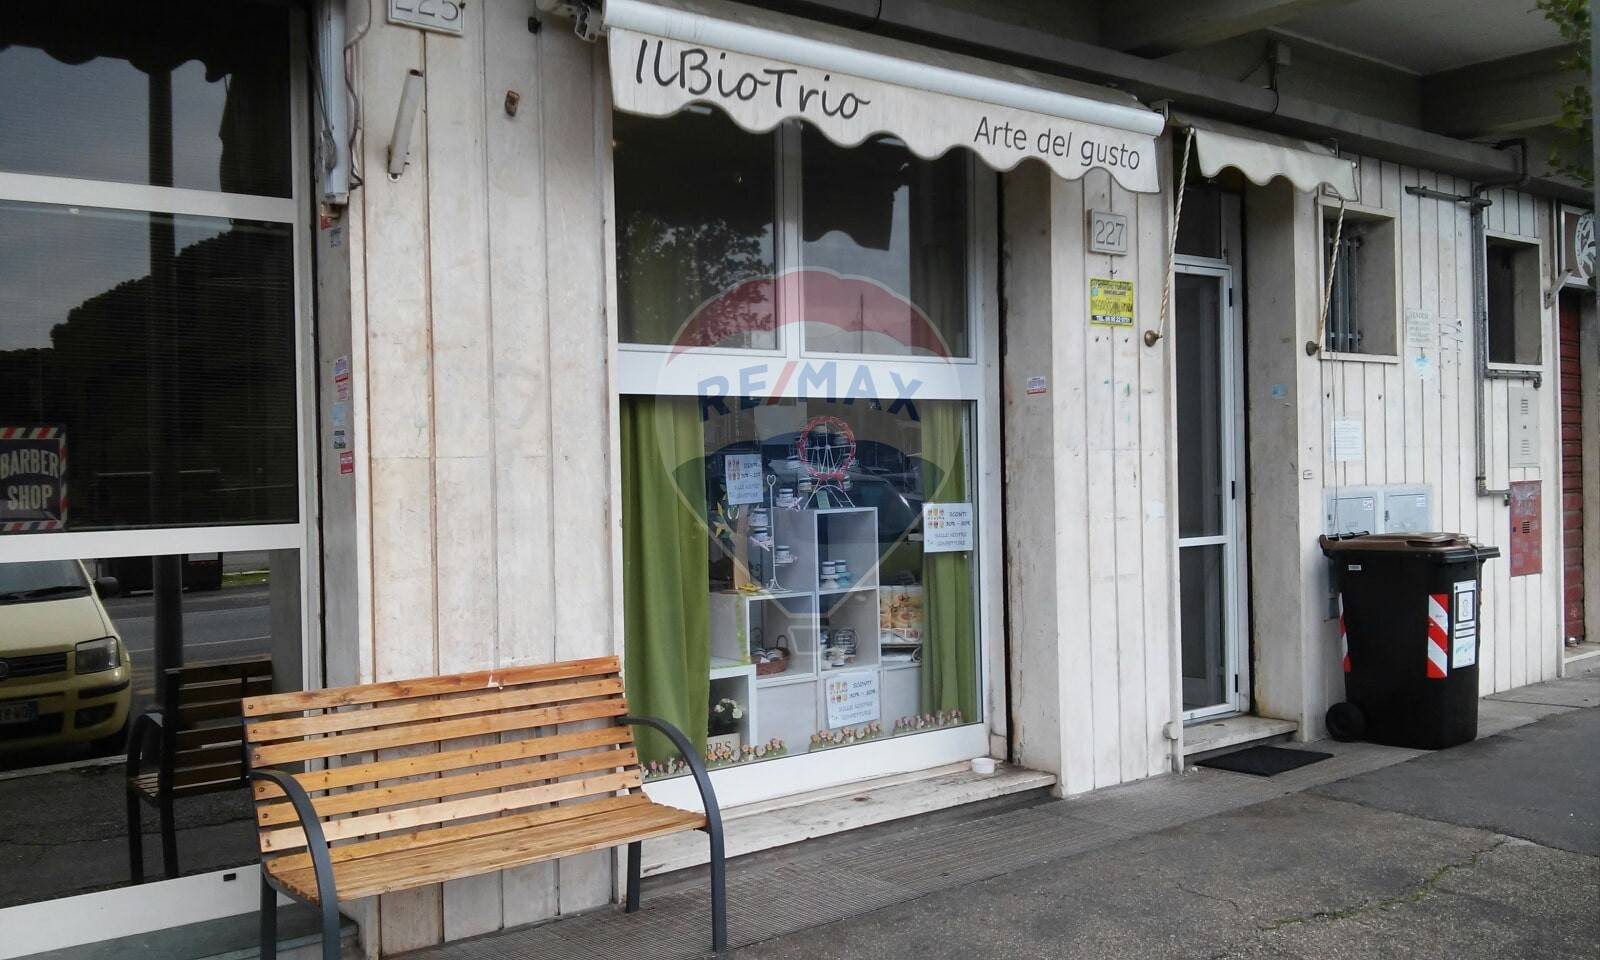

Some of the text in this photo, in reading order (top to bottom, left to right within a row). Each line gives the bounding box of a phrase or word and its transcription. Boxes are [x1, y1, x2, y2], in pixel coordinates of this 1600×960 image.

[974, 116, 1140, 170] Arte del gusto
[1095, 219, 1125, 246] 227
[0, 449, 59, 479] BARBER
[7, 484, 53, 510] SHOP
